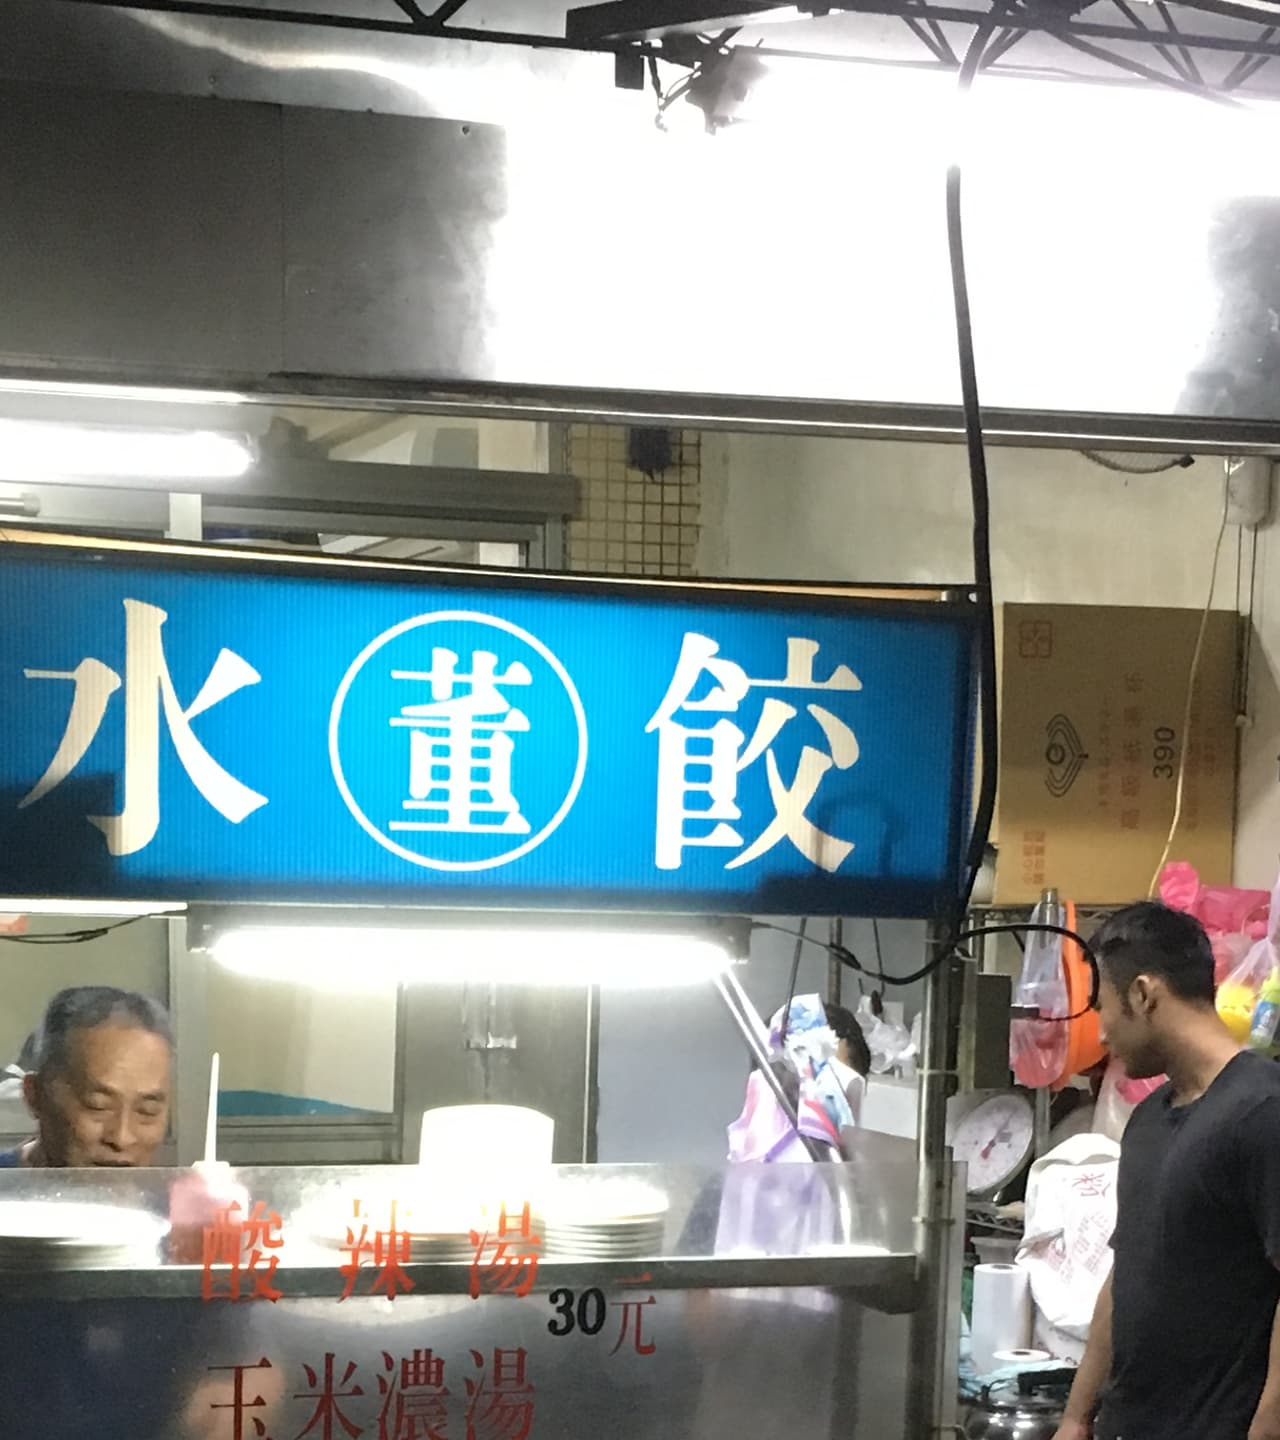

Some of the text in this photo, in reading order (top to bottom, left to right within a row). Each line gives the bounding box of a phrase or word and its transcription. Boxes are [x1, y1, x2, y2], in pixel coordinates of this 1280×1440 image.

[1152, 726, 1176, 779] 390
[200, 1199, 542, 1303] 酸辣湯
